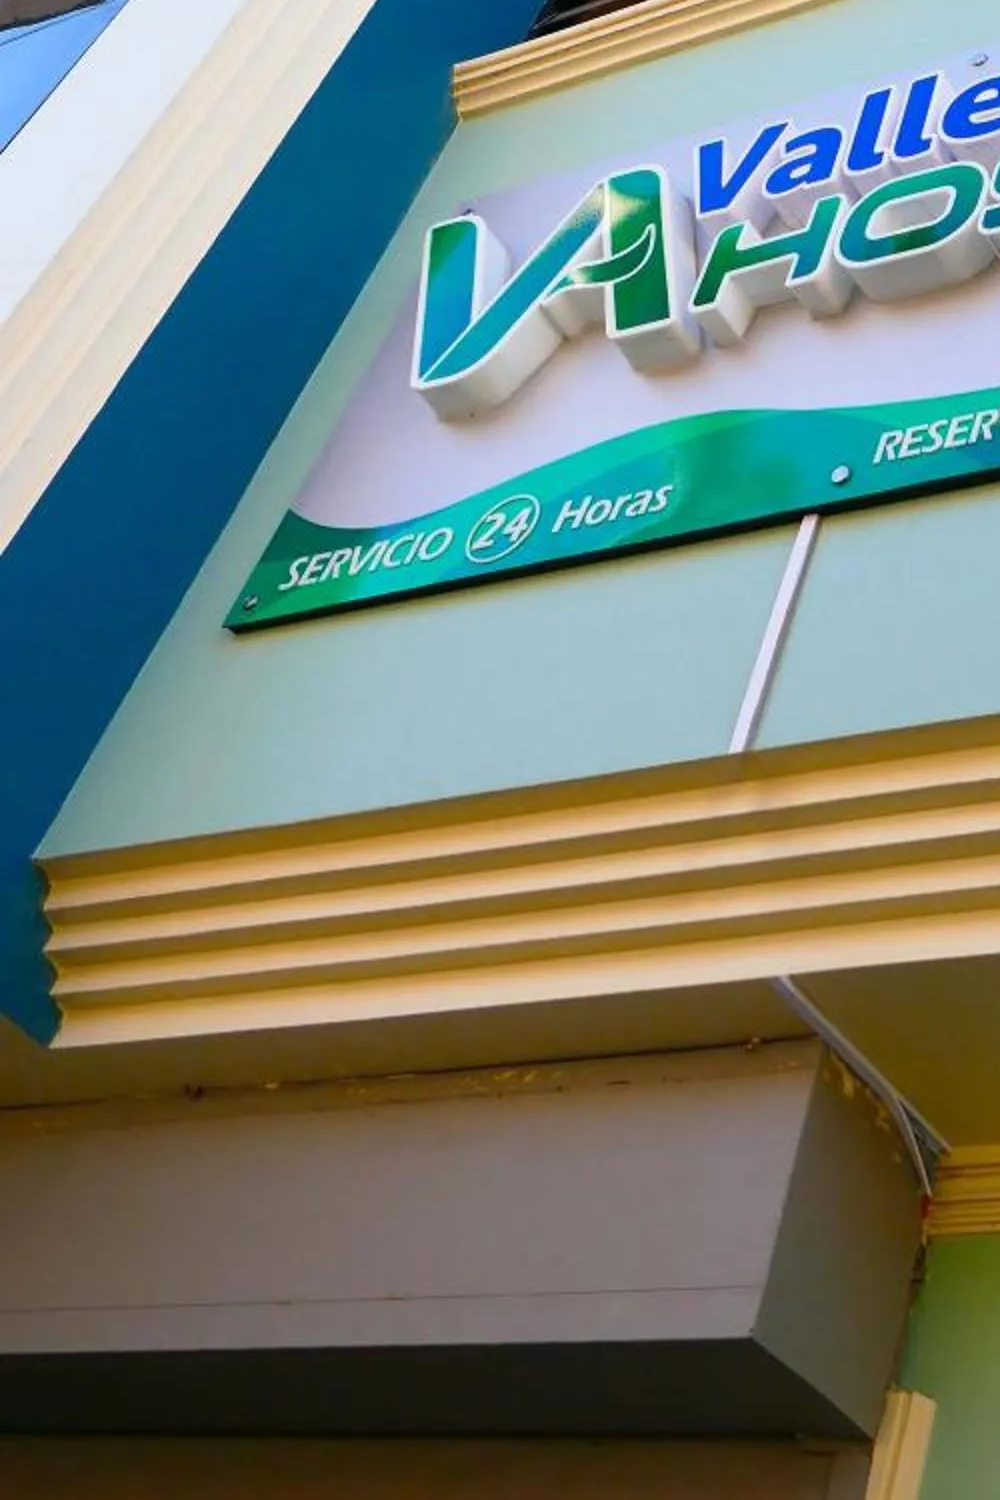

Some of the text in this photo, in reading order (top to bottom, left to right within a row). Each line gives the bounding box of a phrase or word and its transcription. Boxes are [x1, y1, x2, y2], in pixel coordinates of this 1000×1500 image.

[278, 484, 673, 592] SERVICIO 24 Horas
